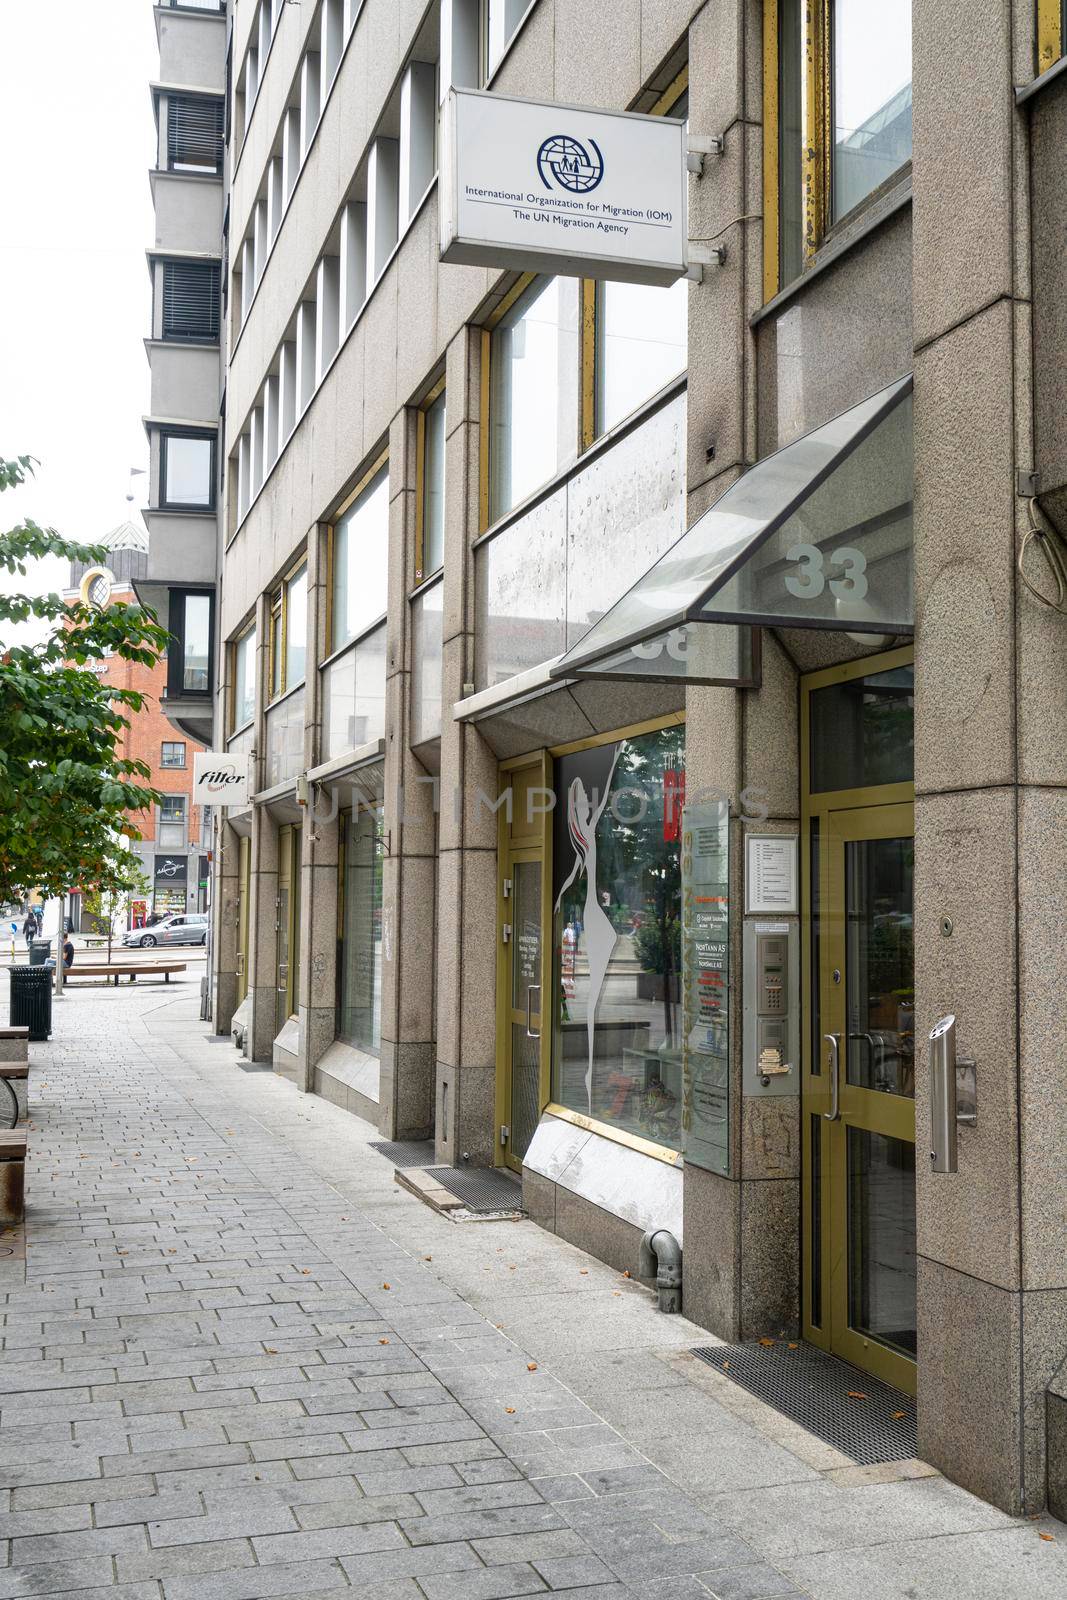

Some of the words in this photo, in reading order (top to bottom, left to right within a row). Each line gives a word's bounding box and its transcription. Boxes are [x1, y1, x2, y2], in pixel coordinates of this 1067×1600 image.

[466, 186, 523, 201] International
[527, 194, 584, 209] Organization
[587, 202, 599, 211] for
[603, 204, 644, 217] Migration
[646, 209, 673, 222] (IOM)
[513, 210, 531, 221] The
[533, 213, 550, 223] UN
[553, 215, 595, 228] Migration
[597, 222, 629, 235] Agency
[784, 543, 868, 600] 33
[198, 771, 246, 785] filter
